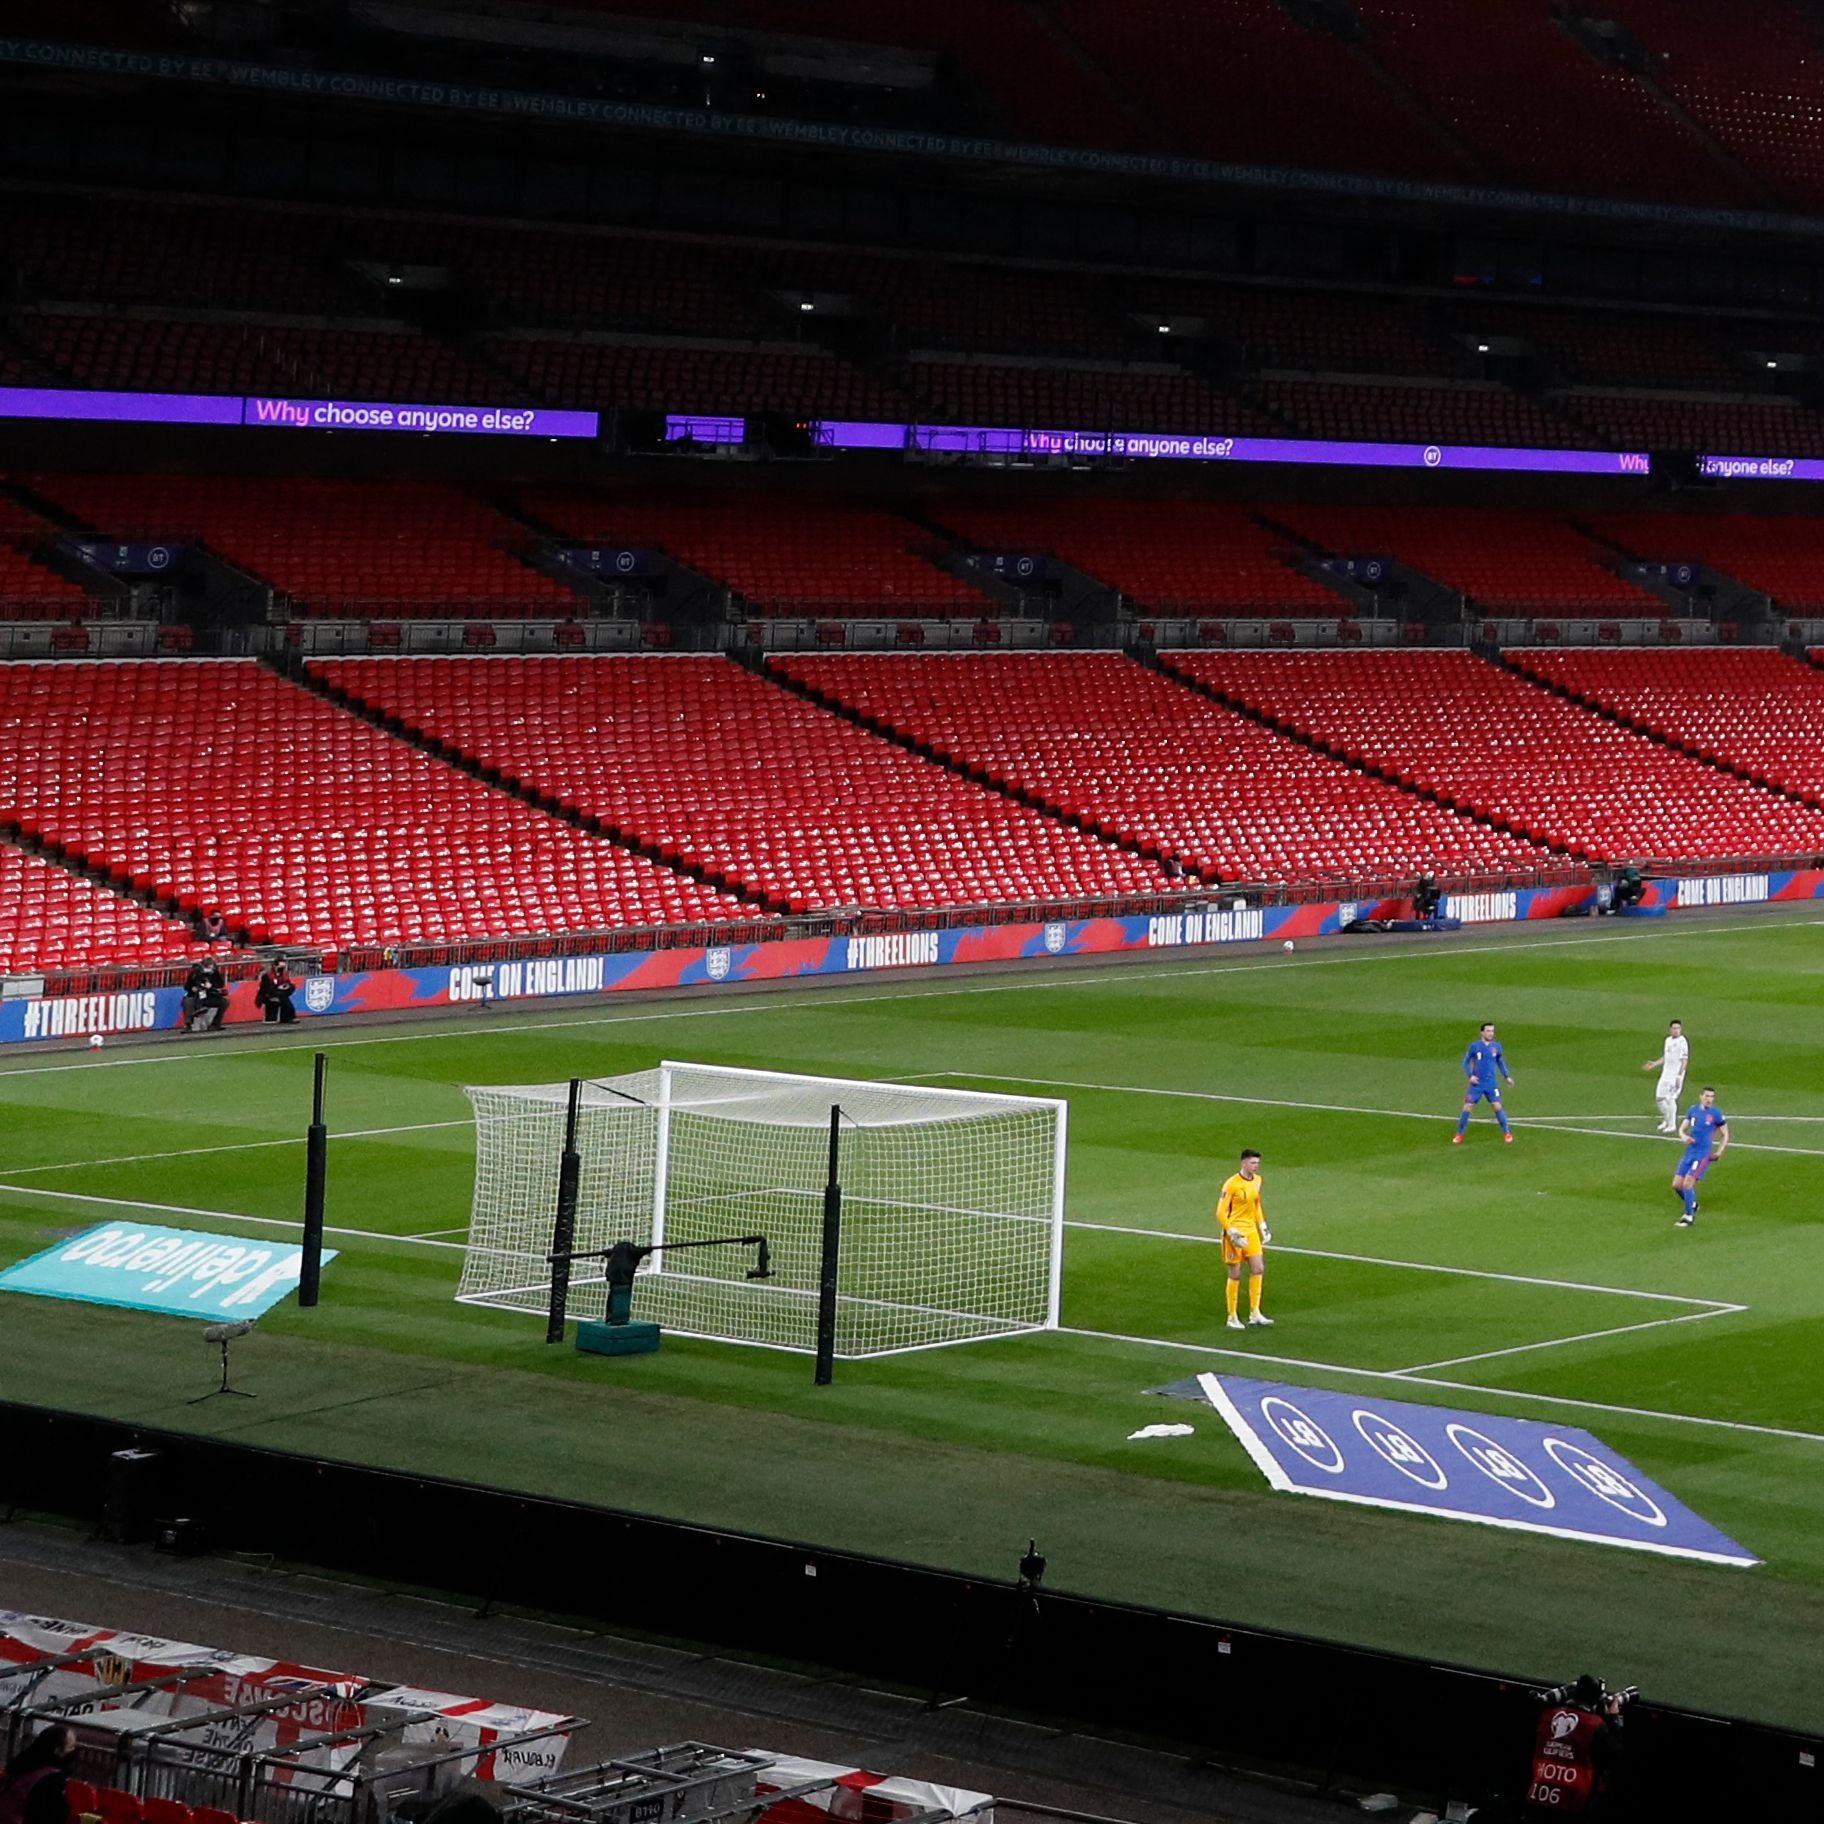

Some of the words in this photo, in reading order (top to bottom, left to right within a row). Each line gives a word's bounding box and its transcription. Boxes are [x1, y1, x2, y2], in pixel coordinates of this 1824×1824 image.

[257, 400, 309, 426] Why
[314, 403, 394, 424] choose
[398, 410, 479, 430] anyone
[482, 410, 534, 430] else?
[1128, 439, 1190, 456] anyone
[1193, 438, 1234, 455] else?
[1759, 459, 1794, 475] else?
[1677, 879, 1705, 906] COME
[1722, 875, 1768, 903] ENGLAND!
[1149, 916, 1182, 945] COME
[1185, 914, 1202, 943] ON
[1205, 909, 1263, 942] ENGLAND!
[847, 932, 938, 968] #THREELIONS
[449, 965, 495, 1001] COME
[500, 963, 522, 997] ON
[526, 957, 604, 995] ENGLAND!
[24, 992, 155, 1038] #THREELIONS
[60, 1229, 273, 1299] deliveroo
[1530, 1783, 1561, 1804] 106
